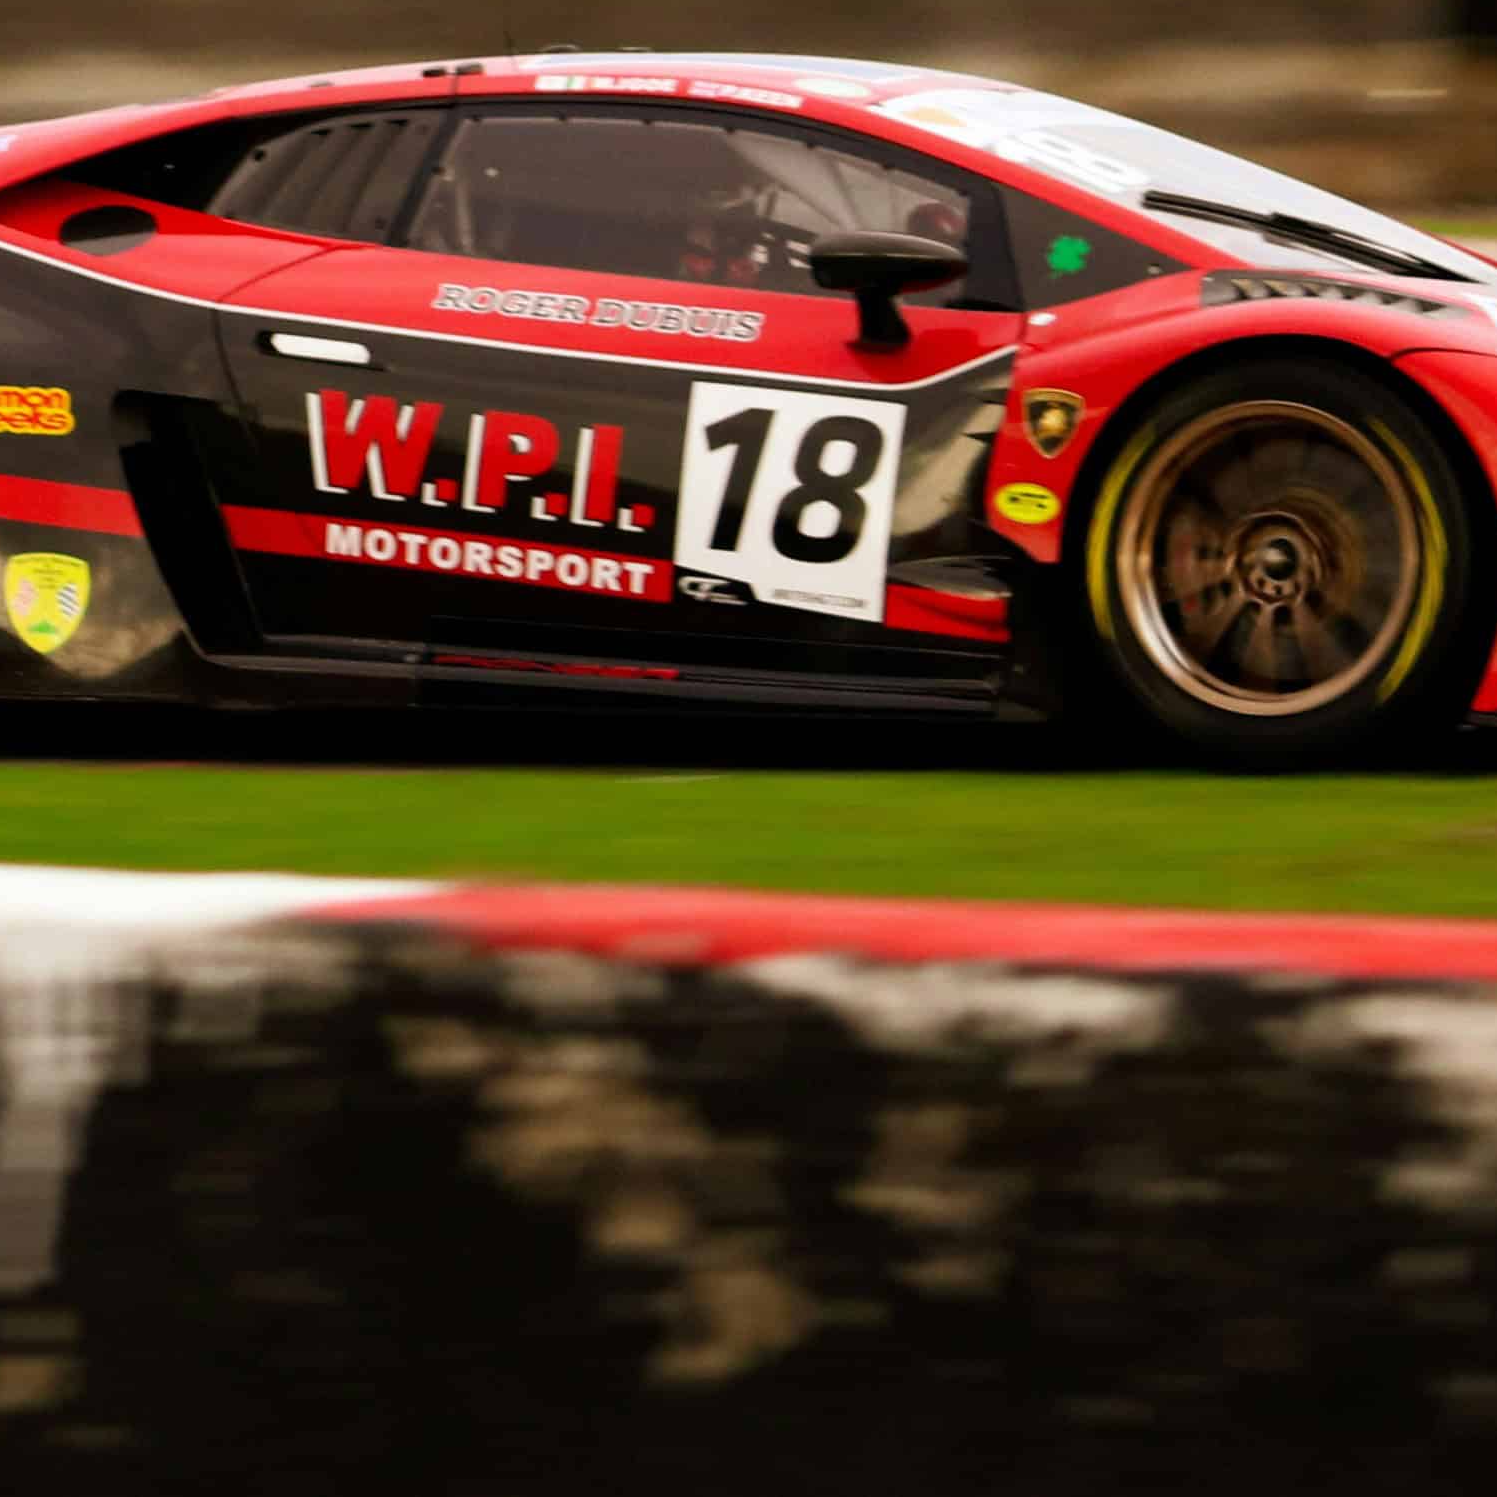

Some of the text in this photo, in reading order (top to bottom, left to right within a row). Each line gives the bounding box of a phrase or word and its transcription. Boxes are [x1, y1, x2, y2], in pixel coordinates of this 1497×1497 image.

[433, 283, 765, 341] ROGER DUBUIS
[307, 389, 655, 532] W.P.I.
[704, 407, 884, 564] 18
[325, 523, 655, 595] MOTORSPORT
